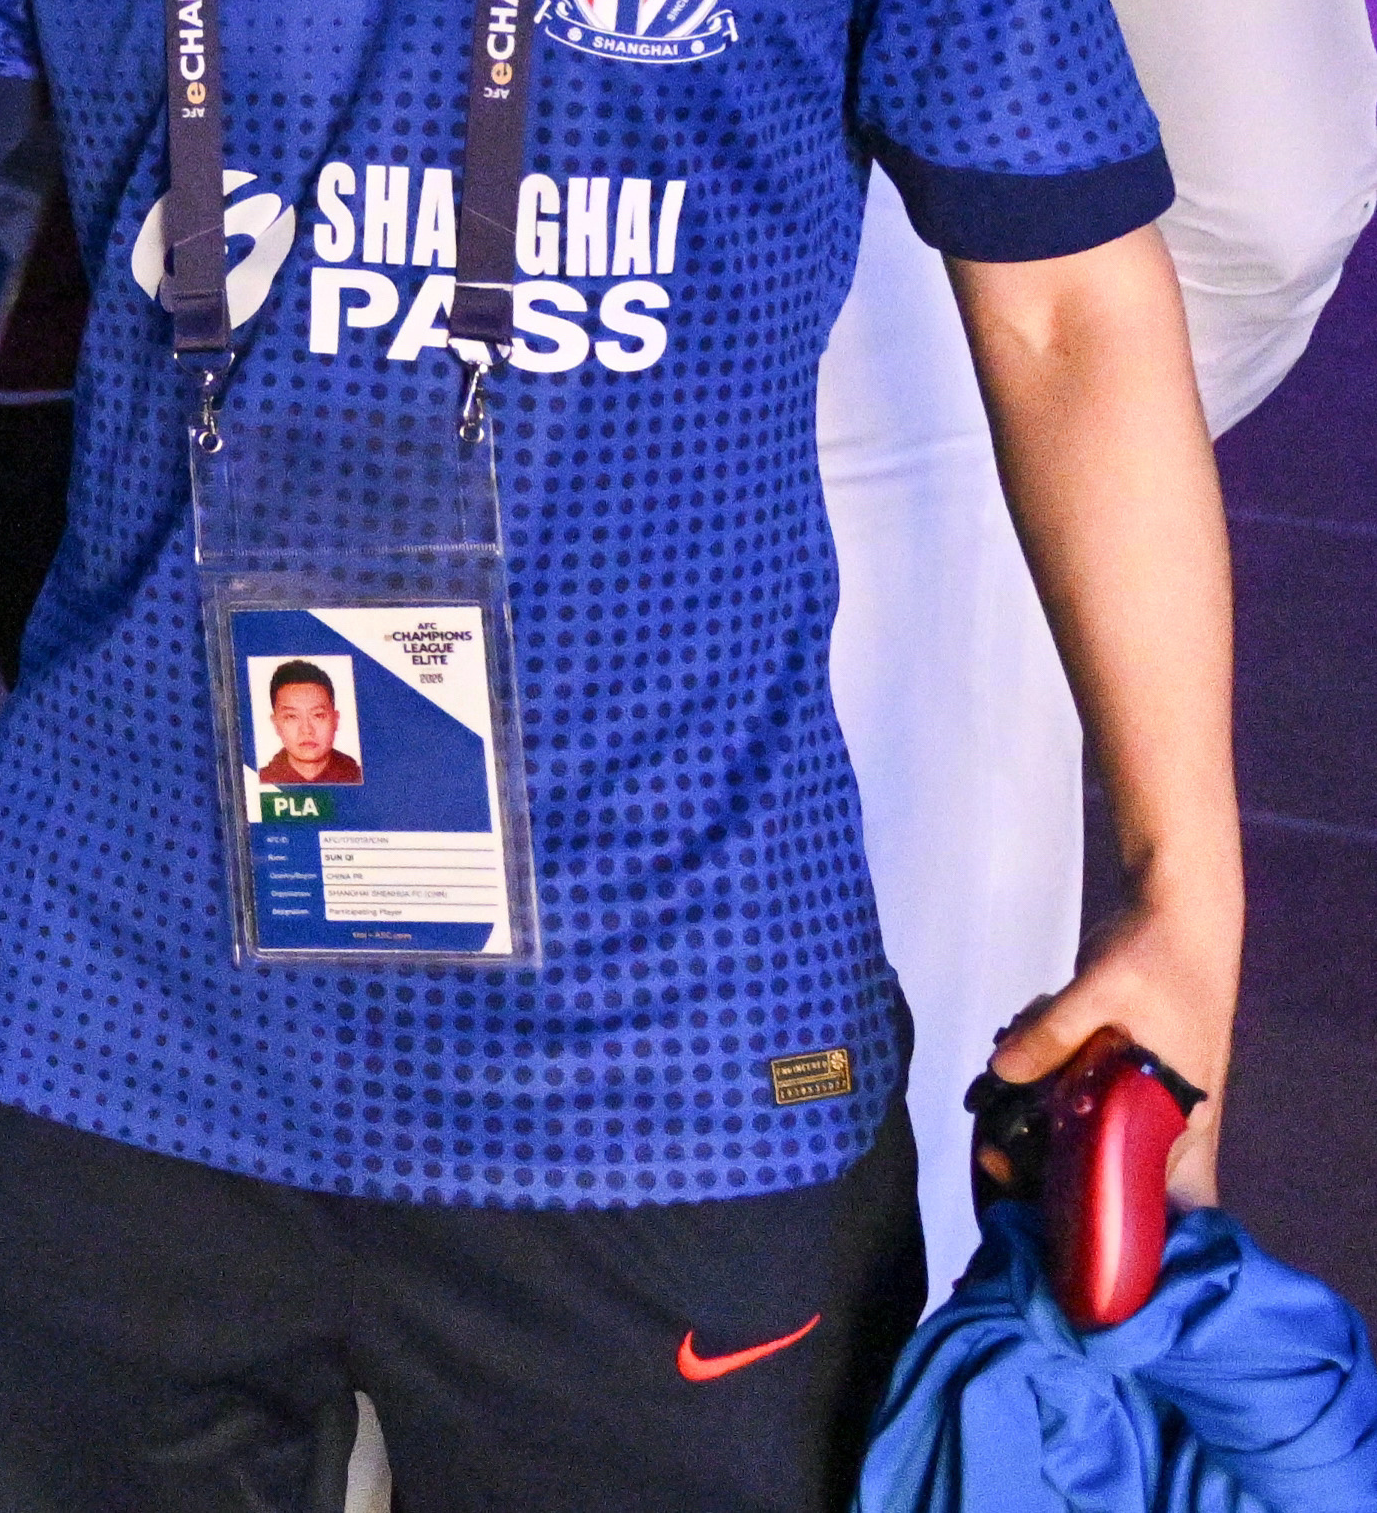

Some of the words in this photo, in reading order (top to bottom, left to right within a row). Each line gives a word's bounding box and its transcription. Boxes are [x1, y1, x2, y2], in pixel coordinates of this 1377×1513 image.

[592, 35, 680, 57] SHANGHAI
[483, 86, 511, 100] AFC
[181, 107, 206, 118] AFC
[313, 161, 687, 278] SHAGHAI
[309, 266, 671, 374] PASS
[417, 622, 438, 630] AFC
[403, 643, 454, 654] LEAGUE
[411, 655, 448, 665] ELITE
[273, 796, 319, 818] PLA
[324, 854, 343, 862] SUN
